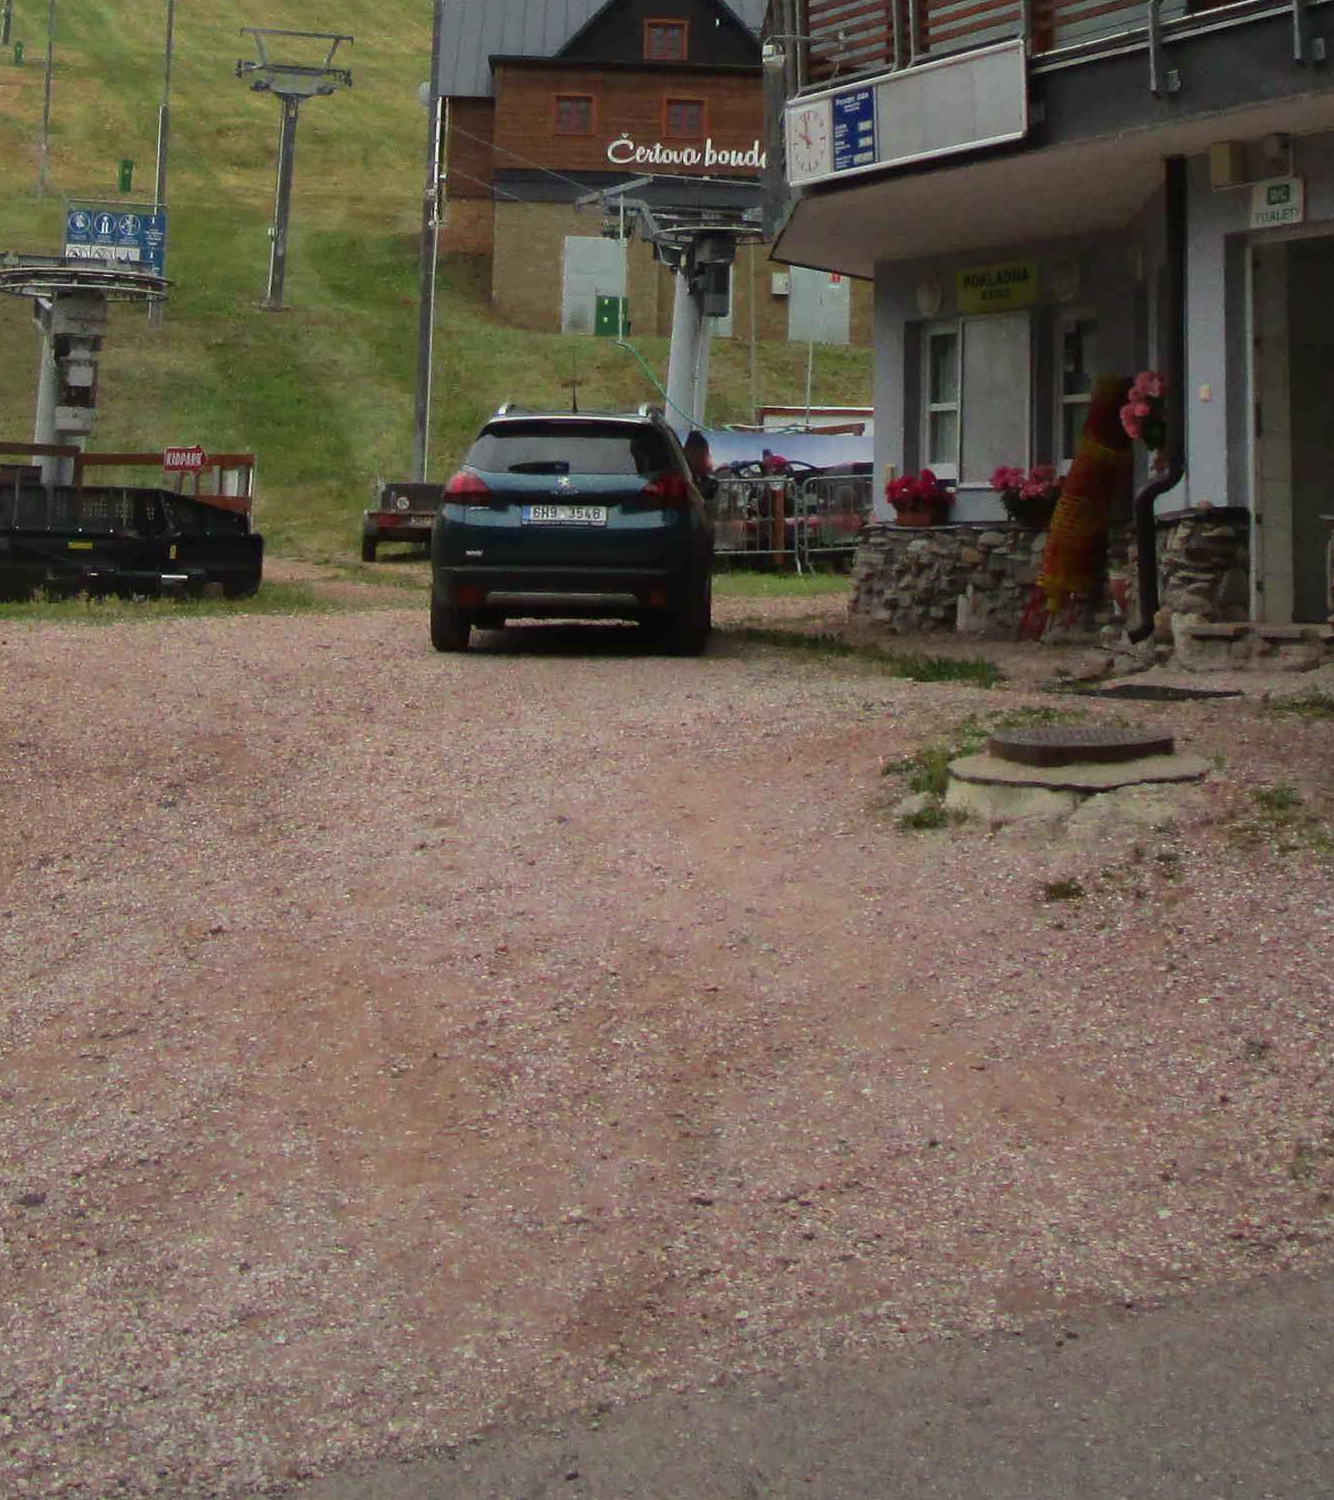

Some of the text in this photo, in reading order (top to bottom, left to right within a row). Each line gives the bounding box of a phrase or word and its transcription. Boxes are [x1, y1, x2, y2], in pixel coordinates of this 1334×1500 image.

[607, 132, 701, 166] Čertova
[963, 268, 1029, 290] POKLADNA
[165, 451, 202, 467] KIDPARK
